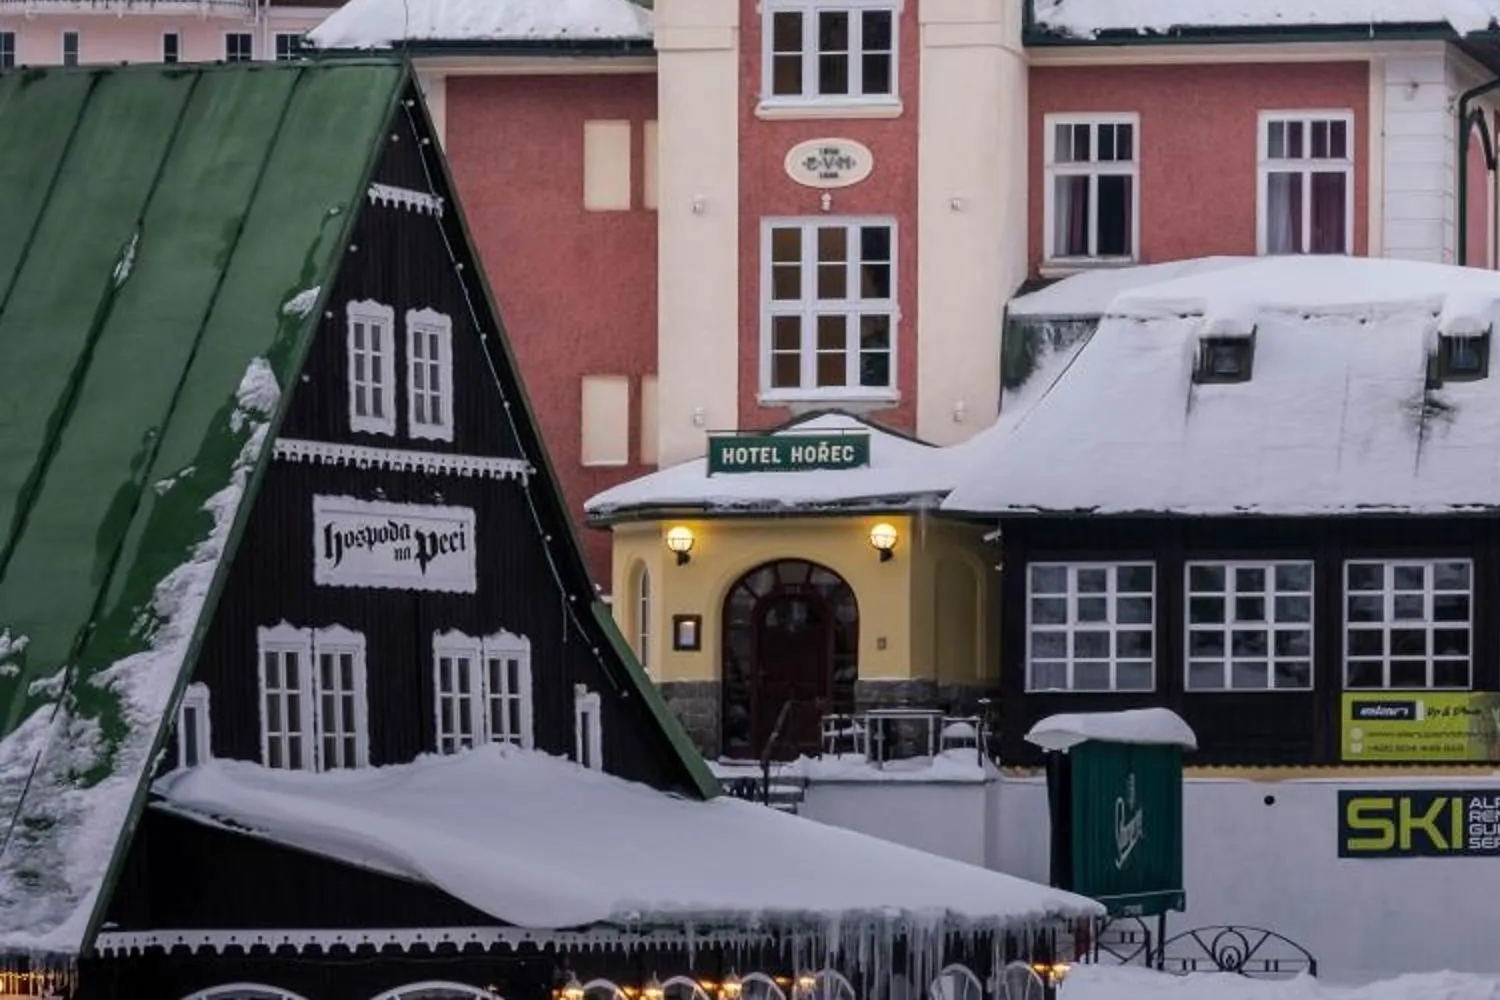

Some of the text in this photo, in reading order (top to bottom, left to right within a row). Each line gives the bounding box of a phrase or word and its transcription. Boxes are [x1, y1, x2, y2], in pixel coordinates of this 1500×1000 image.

[721, 441, 856, 465] HOTEL HOŘEC
[394, 546, 412, 562] na
[1347, 797, 1463, 851] SKI
